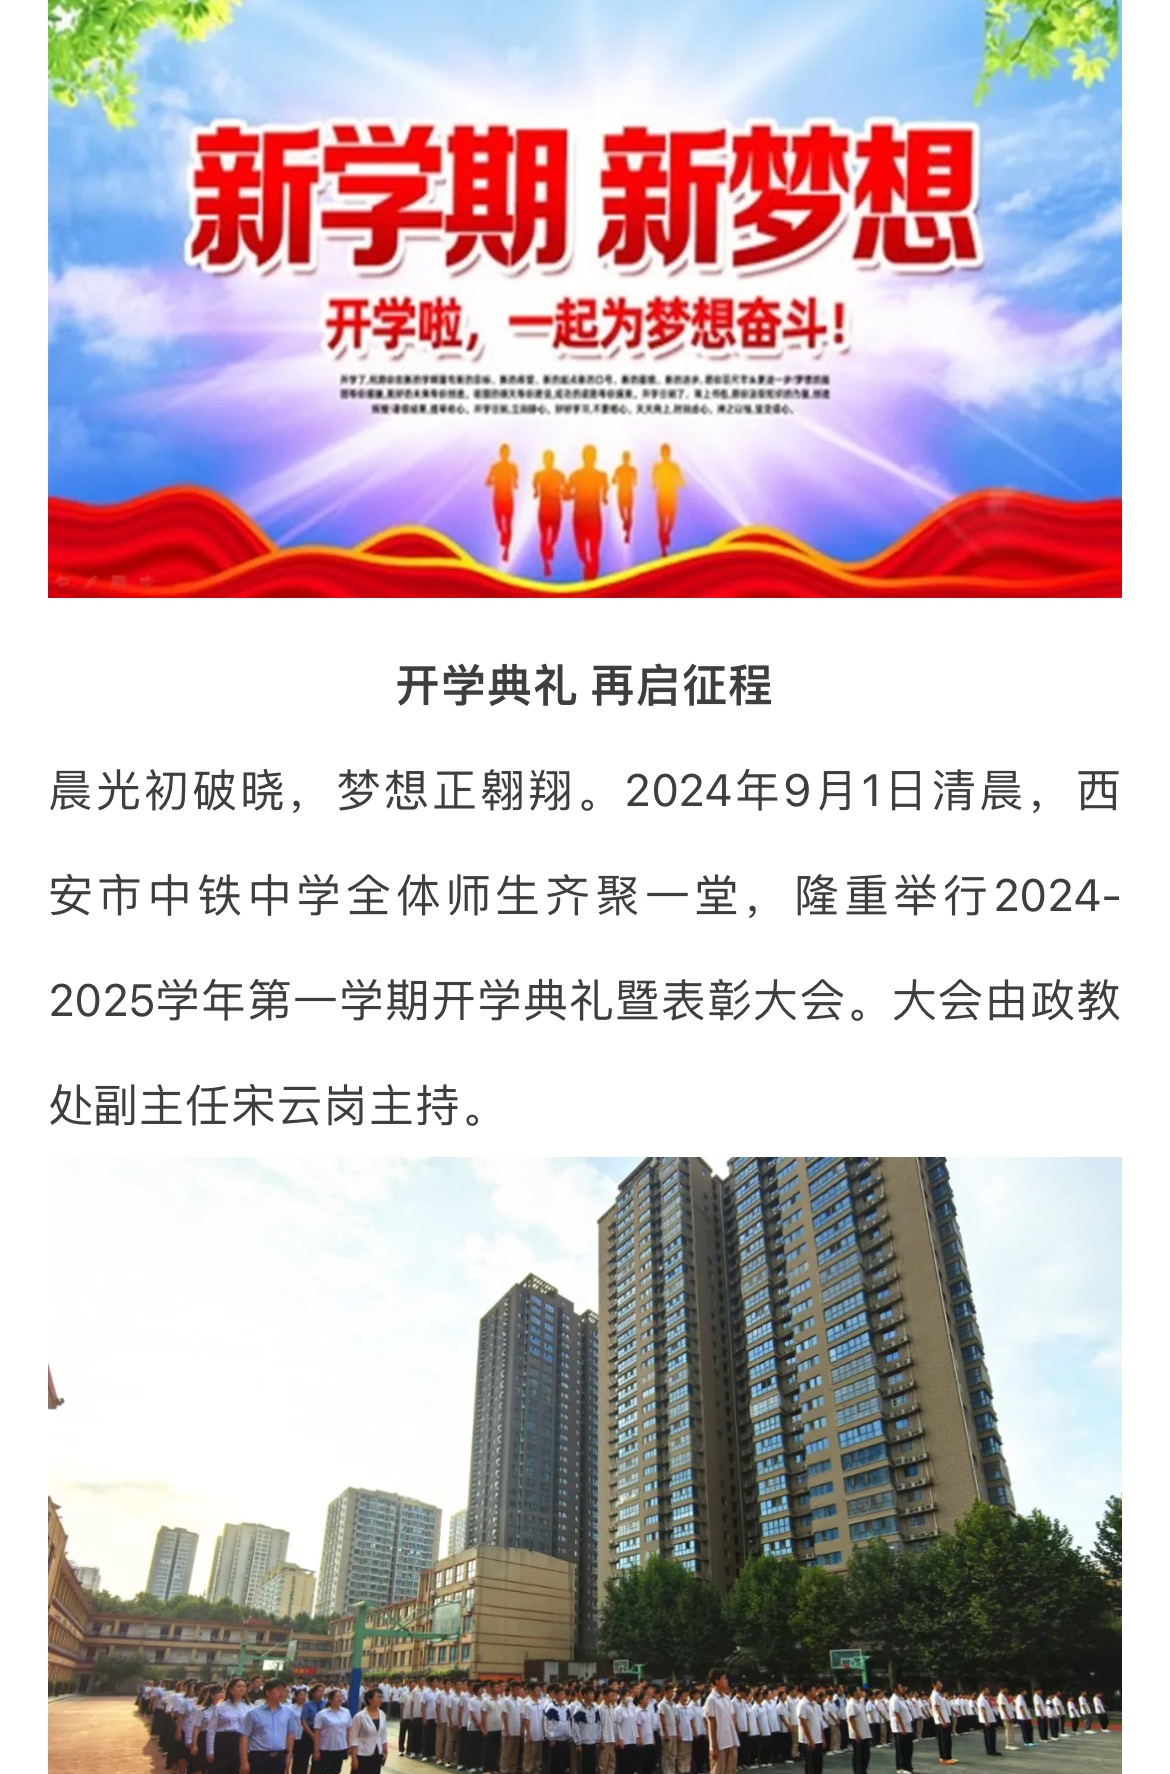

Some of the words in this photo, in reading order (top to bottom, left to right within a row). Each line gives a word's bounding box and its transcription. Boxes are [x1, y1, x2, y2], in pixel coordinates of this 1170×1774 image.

[191, 125, 569, 268] 新学期
[598, 125, 978, 267] 新梦想
[326, 297, 848, 352] 开学啦，一起为梦想奋斗！
[397, 664, 576, 706] 开学典礼
[592, 664, 771, 706] 再启征程
[50, 769, 1119, 813] 晨光初破晓，梦想正翱翔。2024年9月1日清晨，西
[51, 874, 1119, 918] 安市中铁中学全体师生齐聚一堂，隆重举行2024-
[51, 979, 1119, 1021] 2025学年第一学期开学典礼暨表彰大会。大会由政教
[50, 1084, 481, 1126] 处副主任宋云岗主持。
